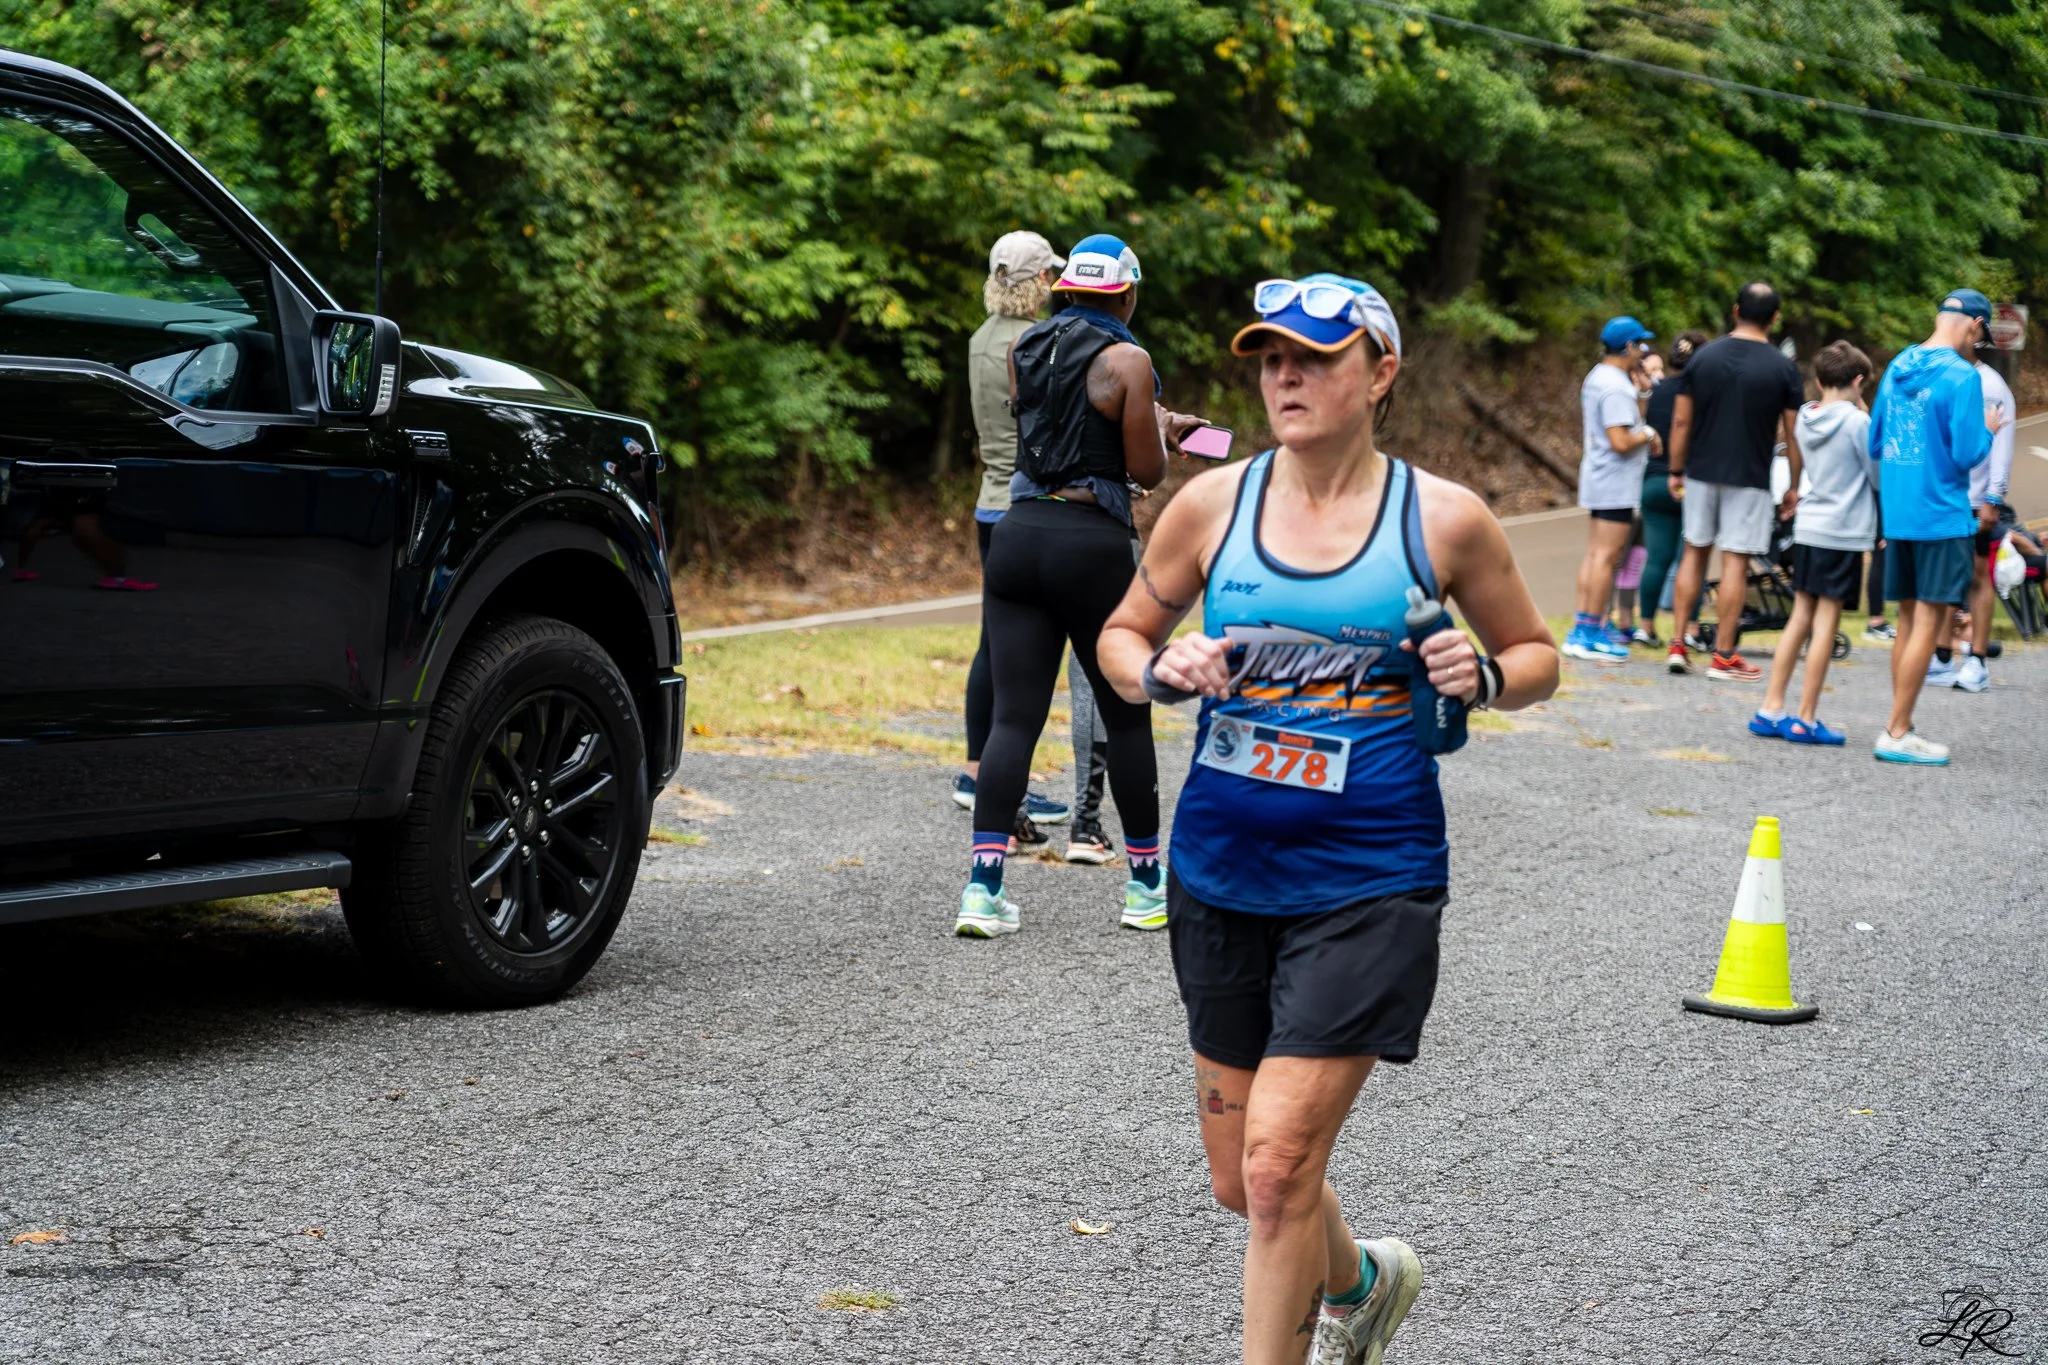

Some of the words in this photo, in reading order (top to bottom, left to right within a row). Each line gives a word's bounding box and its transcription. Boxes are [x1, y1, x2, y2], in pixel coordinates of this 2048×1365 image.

[1339, 625, 1392, 641] MEMPHIS
[1223, 622, 1384, 694] THUNDER
[1242, 699, 1343, 722] RACING
[1248, 743, 1328, 787] 278
